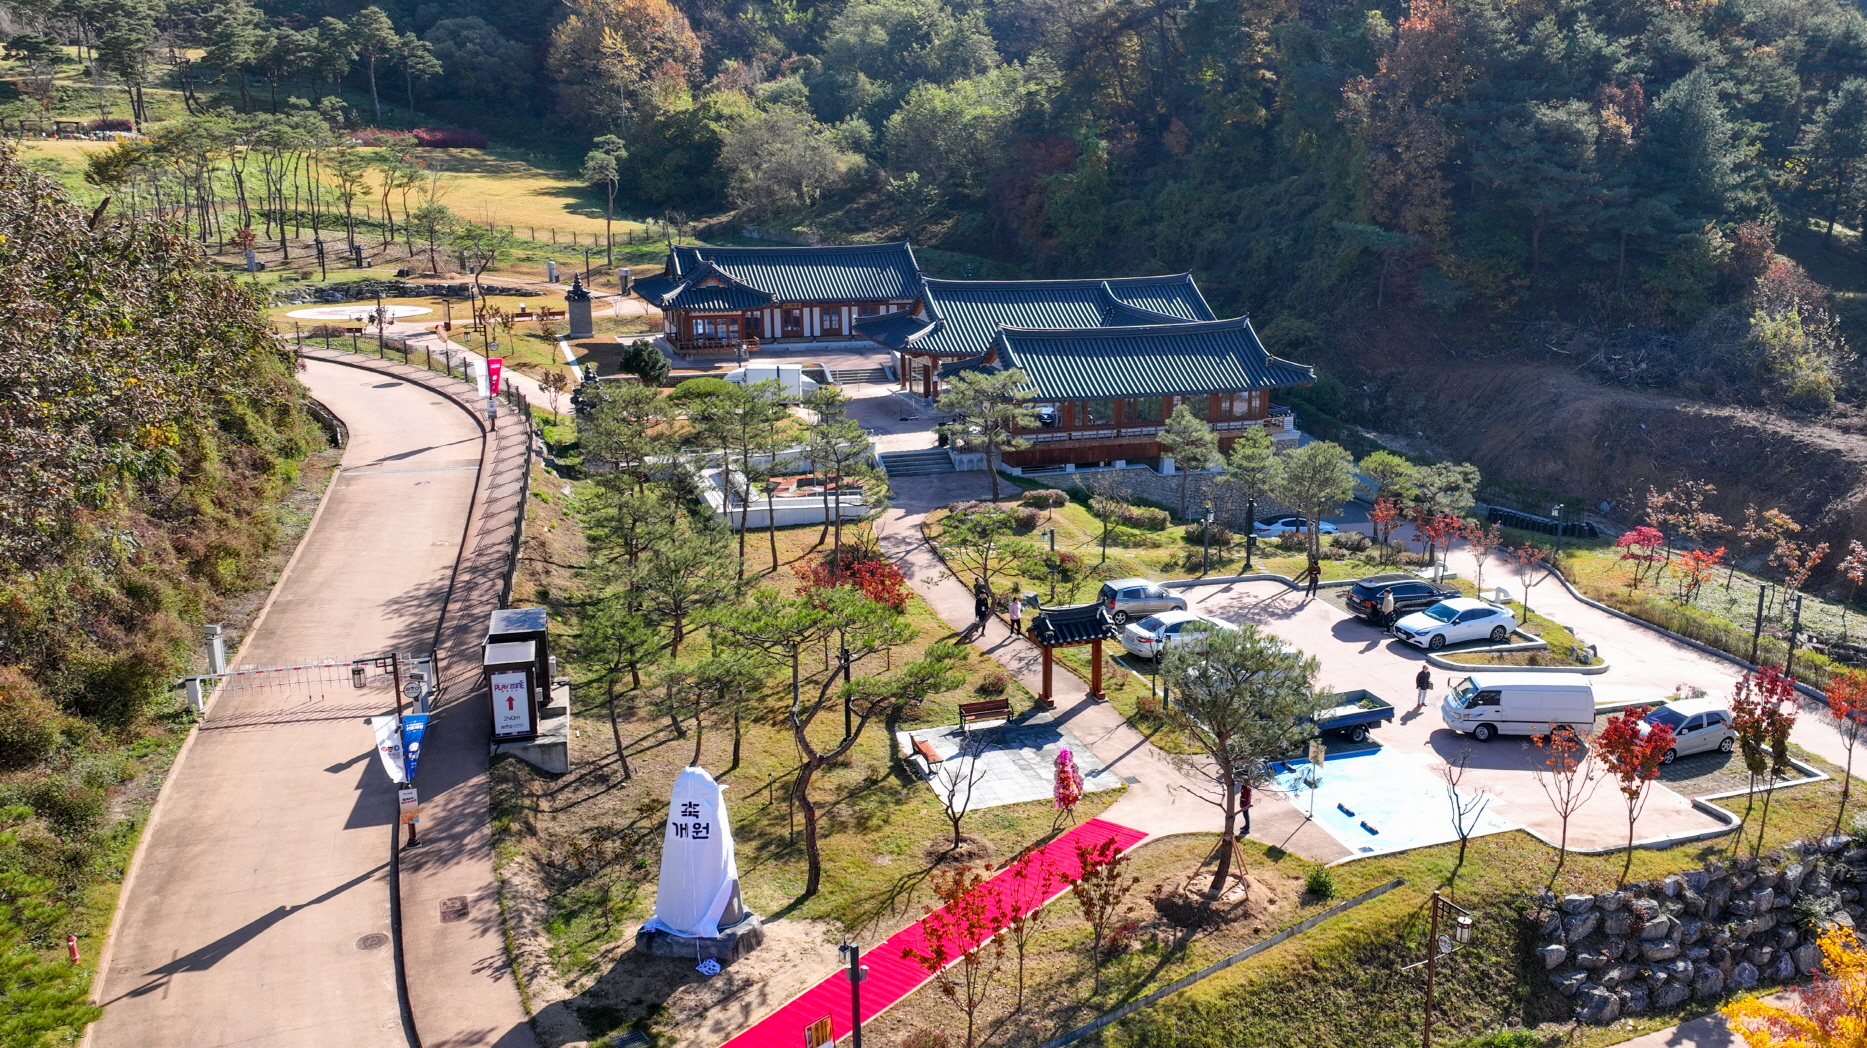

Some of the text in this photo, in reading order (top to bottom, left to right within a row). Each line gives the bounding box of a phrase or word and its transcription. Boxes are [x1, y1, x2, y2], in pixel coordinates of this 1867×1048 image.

[510, 680, 525, 689] ZONE
[681, 801, 700, 819] 축
[672, 822, 710, 839] 개원
